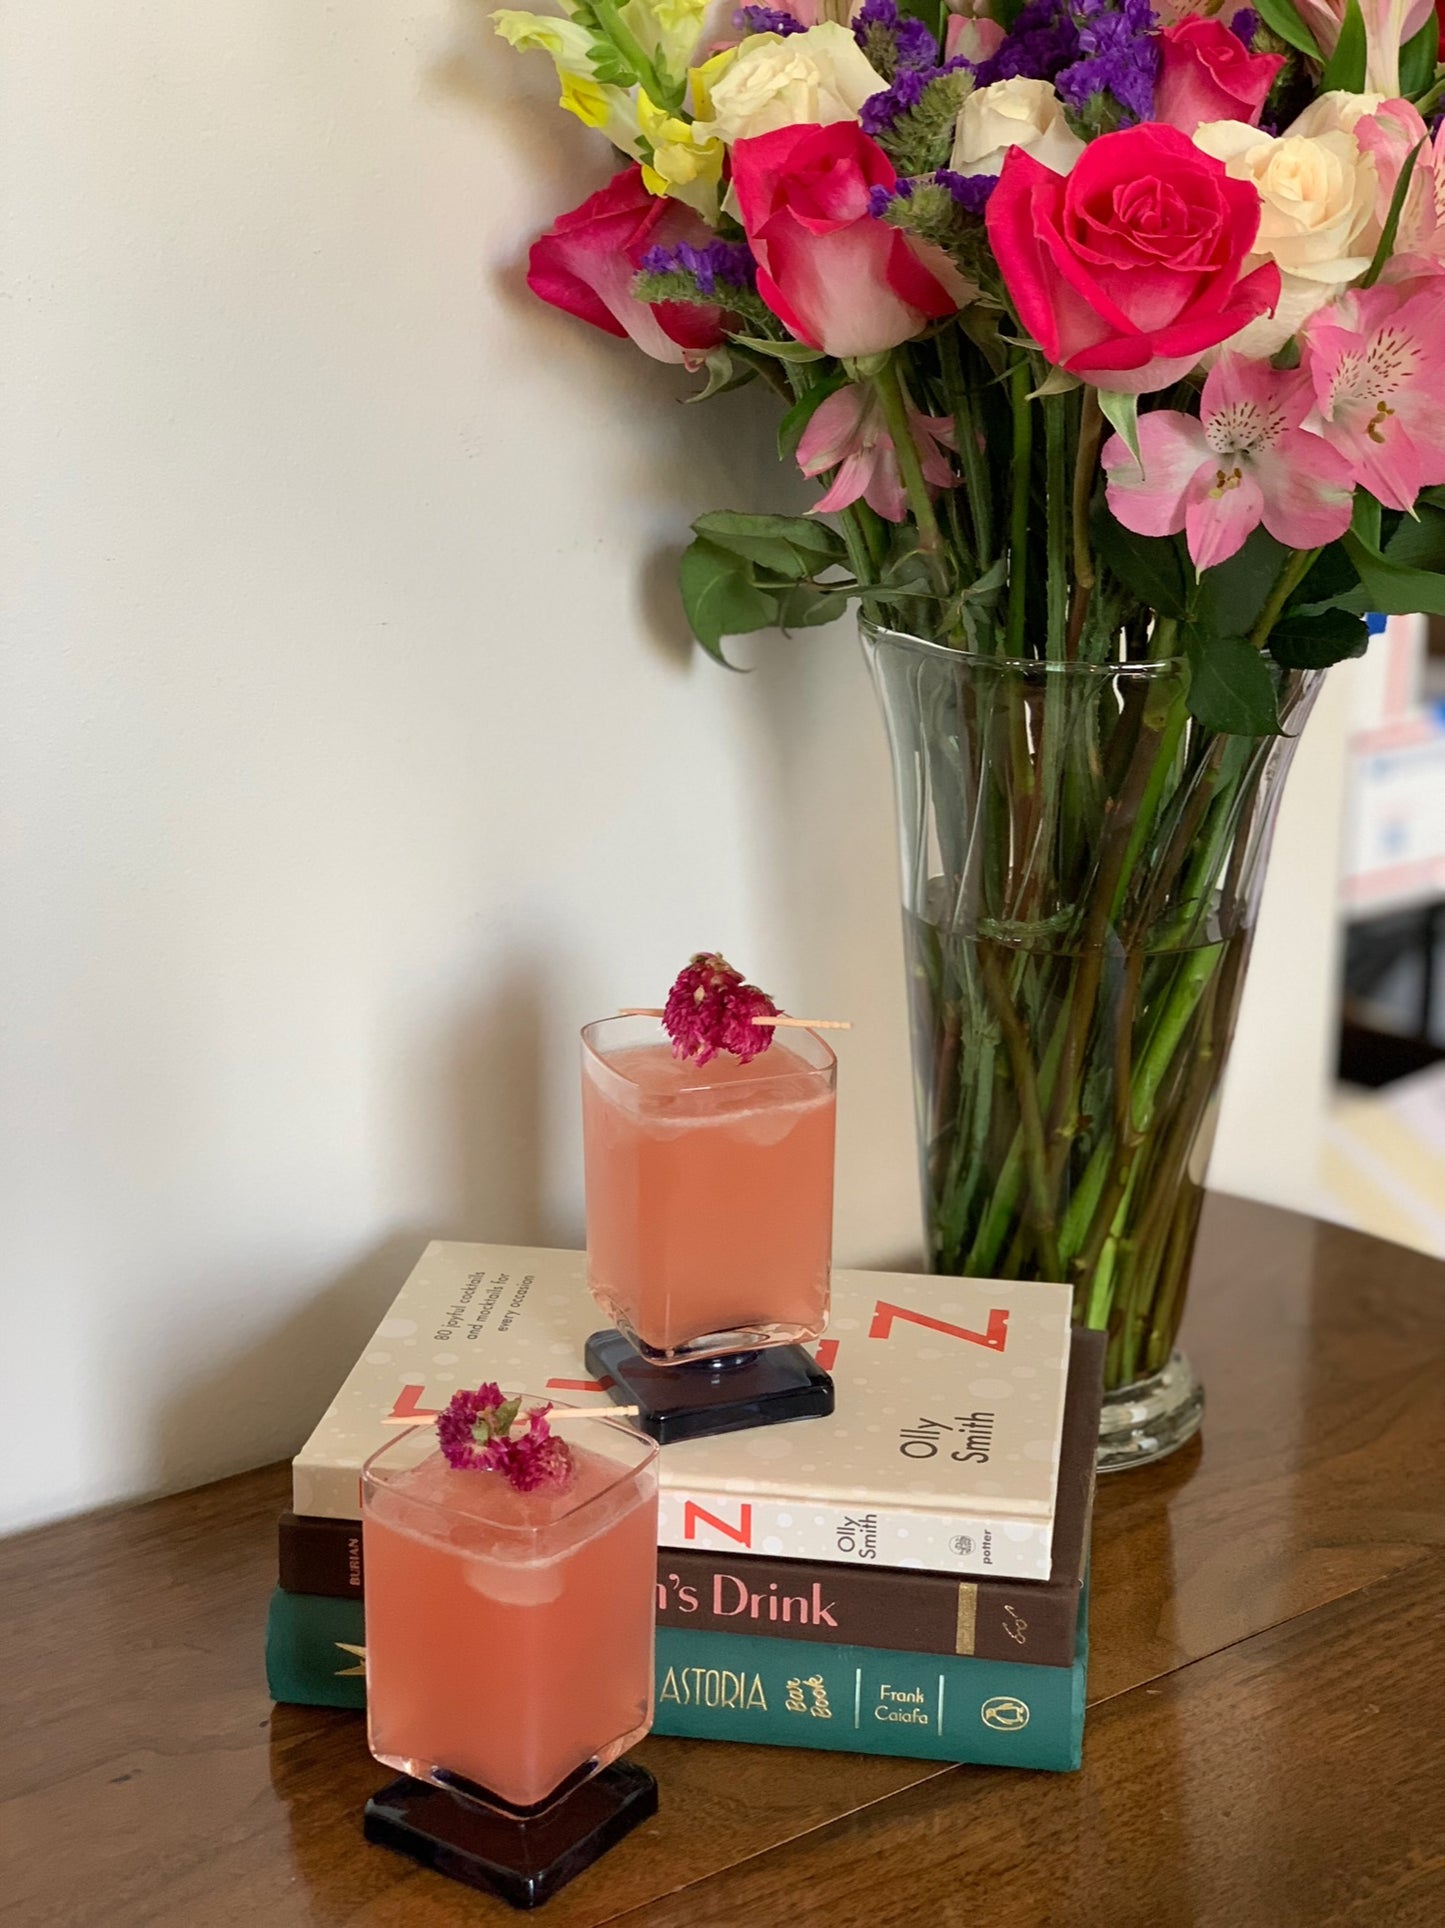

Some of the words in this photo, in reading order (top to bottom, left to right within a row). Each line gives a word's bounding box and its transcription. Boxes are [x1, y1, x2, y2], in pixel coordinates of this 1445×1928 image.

[459, 1271, 485, 1304] cocktails
[489, 1273, 510, 1285] for
[441, 1305, 466, 1329] joyful
[477, 1286, 504, 1323] mocktails
[496, 1309, 521, 1332] every
[509, 1275, 535, 1308] occasion
[434, 1329, 453, 1341] 80
[466, 1323, 484, 1340] and
[900, 1417, 954, 1460] Olly
[951, 1410, 996, 1463] Smith
[837, 1515, 861, 1553] Olly
[858, 1513, 878, 1559] Smith
[982, 1528, 993, 1565] potter
[348, 1538, 361, 1586] BURIAN
[713, 1574, 838, 1627] Drink
[659, 1666, 768, 1711] ASTORIA
[785, 1677, 808, 1713] Bar
[801, 1673, 833, 1719] Book
[879, 1684, 925, 1704] Frank
[874, 1705, 930, 1726] Caiafa
